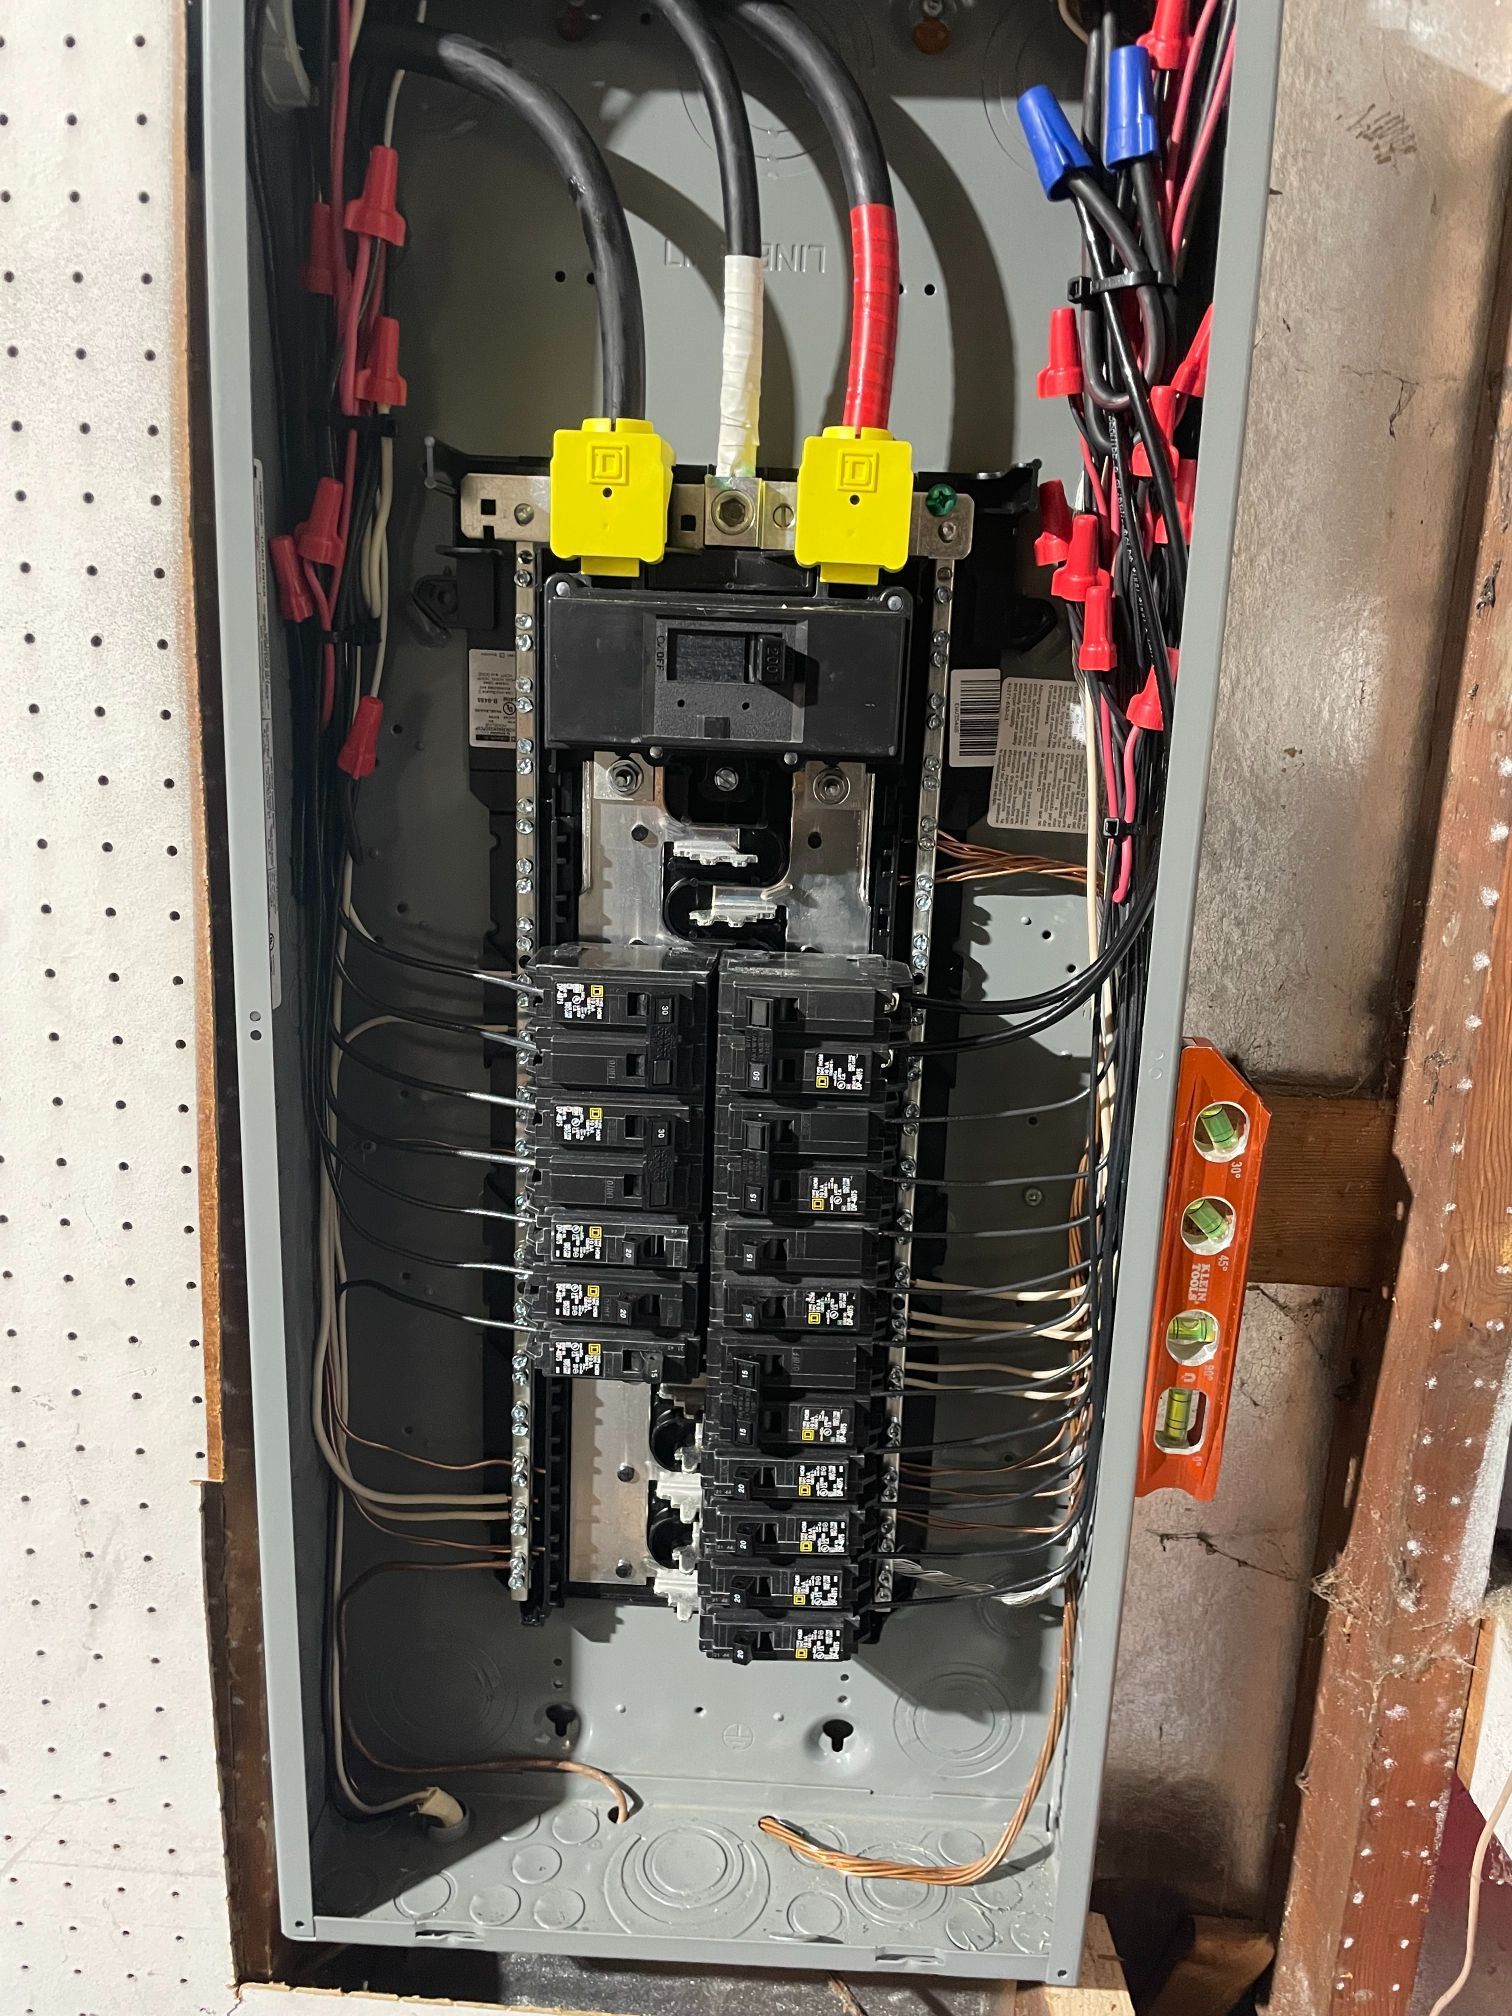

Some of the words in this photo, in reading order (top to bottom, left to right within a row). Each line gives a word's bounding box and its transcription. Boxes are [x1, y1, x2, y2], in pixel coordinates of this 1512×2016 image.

[766, 647, 780, 674] 200
[662, 1005, 670, 1016] 30
[752, 1071, 760, 1081] 50
[658, 1128, 666, 1138] 30
[1230, 1161, 1242, 1178] 30°
[750, 1193, 757, 1202] 15
[625, 1248, 632, 1258] 20
[746, 1254, 752, 1262] 15
[1218, 1254, 1230, 1272] 45°
[1188, 1263, 1202, 1302] TOOLS
[1198, 1264, 1210, 1302] KLEIN
[620, 1308, 627, 1319] 20
[745, 1313, 752, 1322] 15
[650, 1369, 658, 1378] 15
[741, 1370, 748, 1378] 15
[740, 1428, 747, 1436] 15
[738, 1484, 745, 1494] 20
[740, 1540, 747, 1550] 20
[734, 1594, 741, 1604] 20
[736, 1650, 744, 1660] 20
